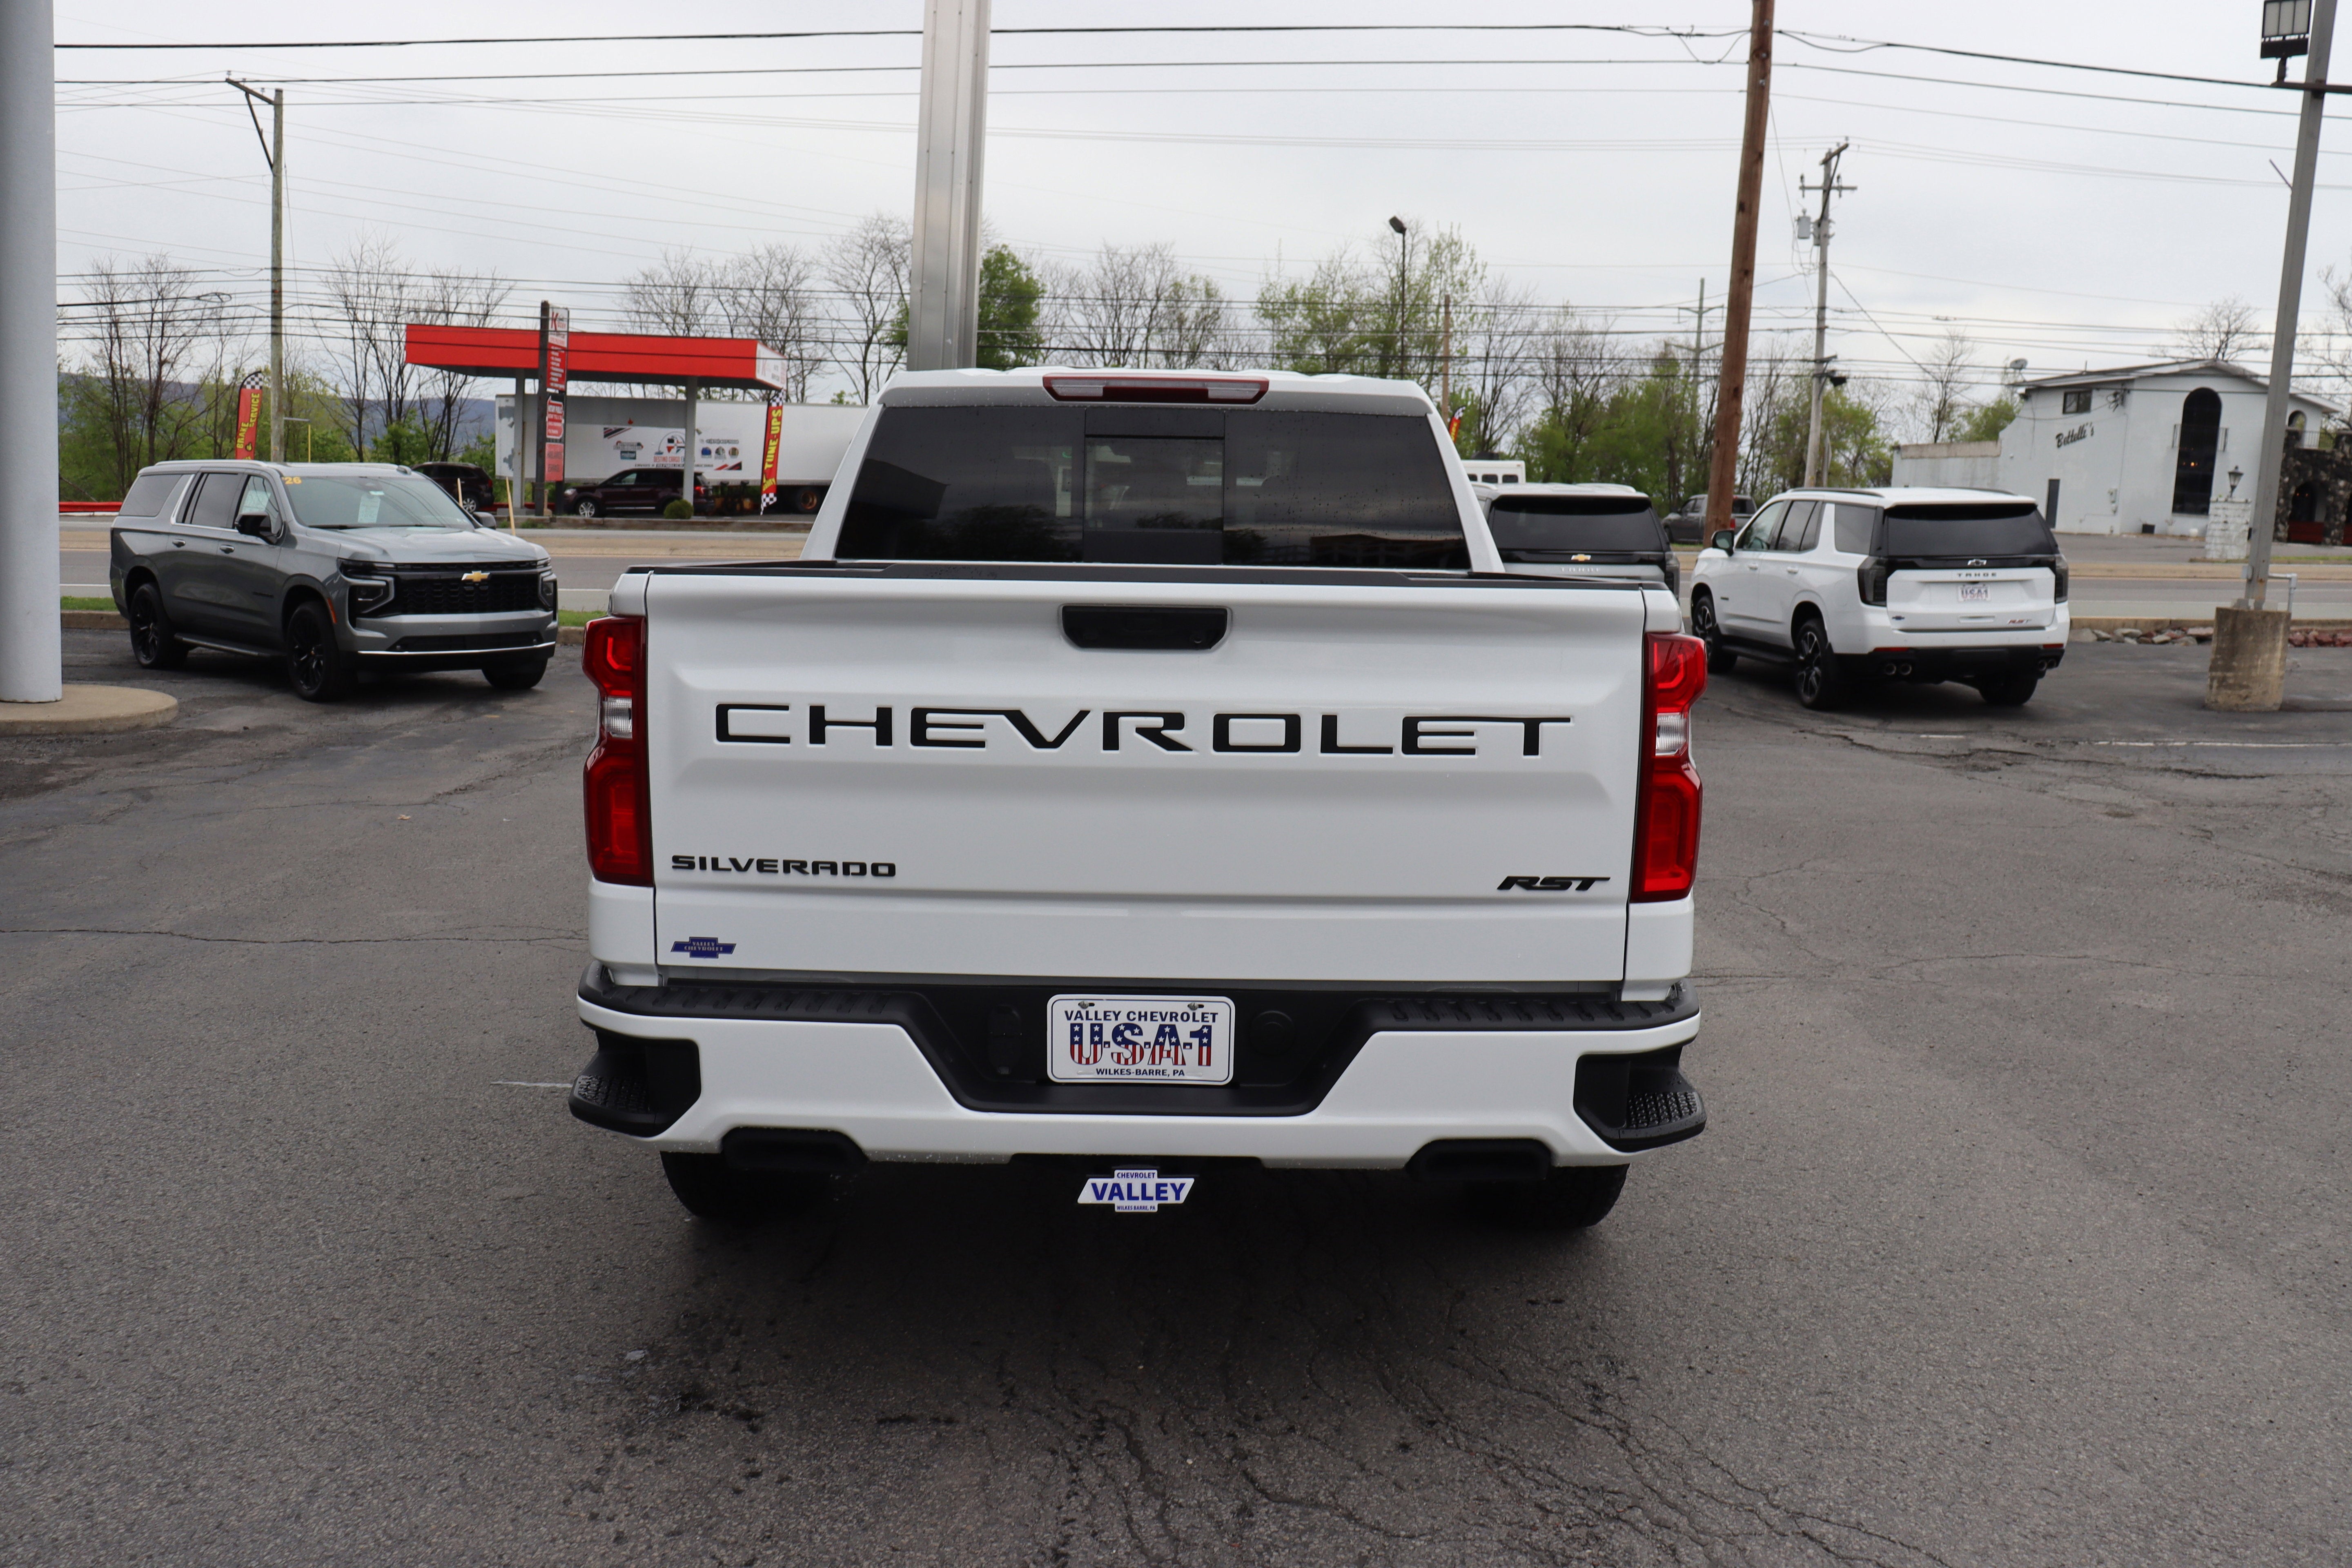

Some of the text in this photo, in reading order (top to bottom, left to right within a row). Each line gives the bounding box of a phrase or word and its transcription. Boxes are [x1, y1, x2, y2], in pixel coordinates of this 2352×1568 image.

[236, 422, 249, 448] BRAKE
[764, 409, 782, 470] TUNE-UPS
[715, 703, 1571, 756] CHEVROLET
[672, 855, 896, 878] SILVERADO
[1497, 875, 1611, 891] RST
[1064, 1010, 1218, 1023] VALLEY CHEVROLET
[1096, 1068, 1170, 1077] WILKES-BARRE,
[1091, 1182, 1186, 1201] VALLEY
